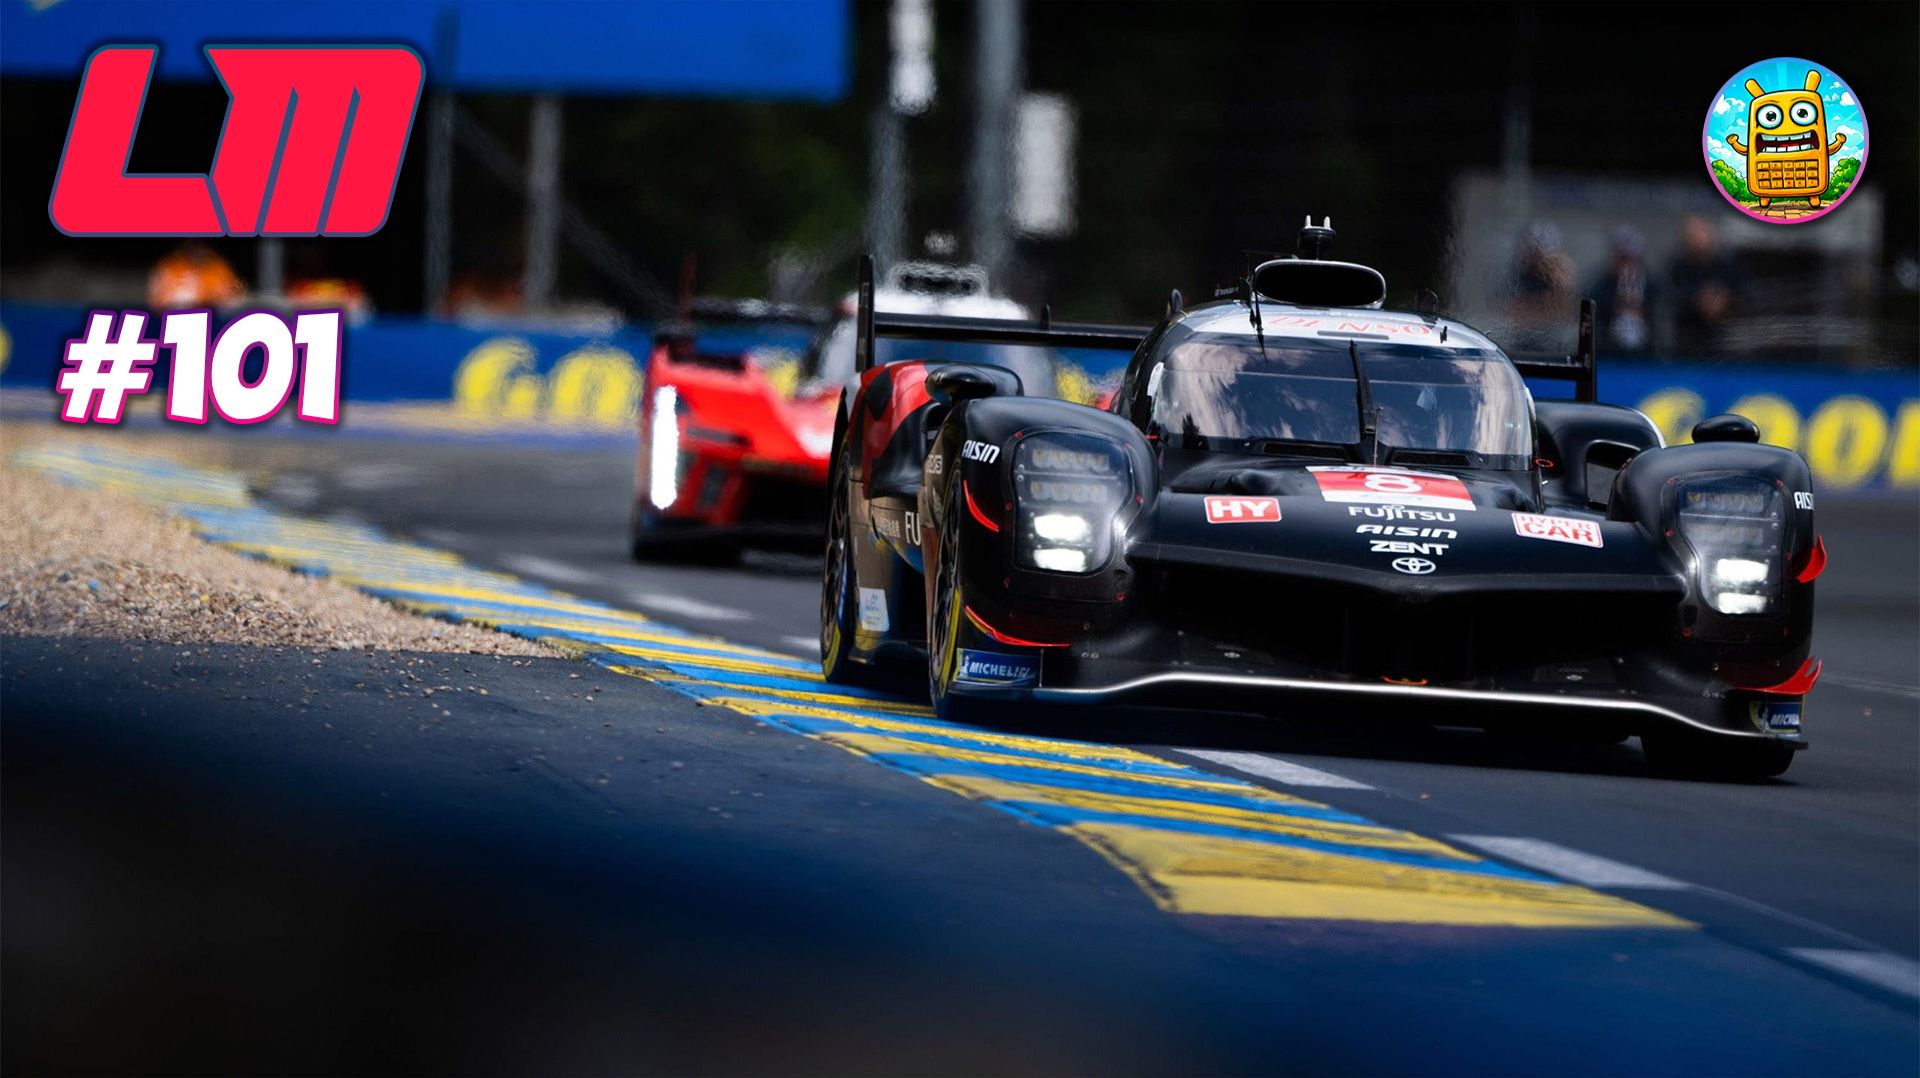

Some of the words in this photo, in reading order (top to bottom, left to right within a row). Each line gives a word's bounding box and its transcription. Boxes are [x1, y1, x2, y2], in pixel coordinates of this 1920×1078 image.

[1269, 315, 1432, 335] DENSO
[961, 439, 1000, 464] AISIN
[1365, 473, 1423, 493] 8
[1211, 500, 1272, 518] HY
[1348, 504, 1456, 522] FUJITSU
[905, 511, 920, 546] FU
[1356, 524, 1457, 539] AISIN
[1523, 522, 1594, 543] CAR
[1369, 540, 1449, 555] ZENT
[969, 661, 1030, 679] MICHELIN
